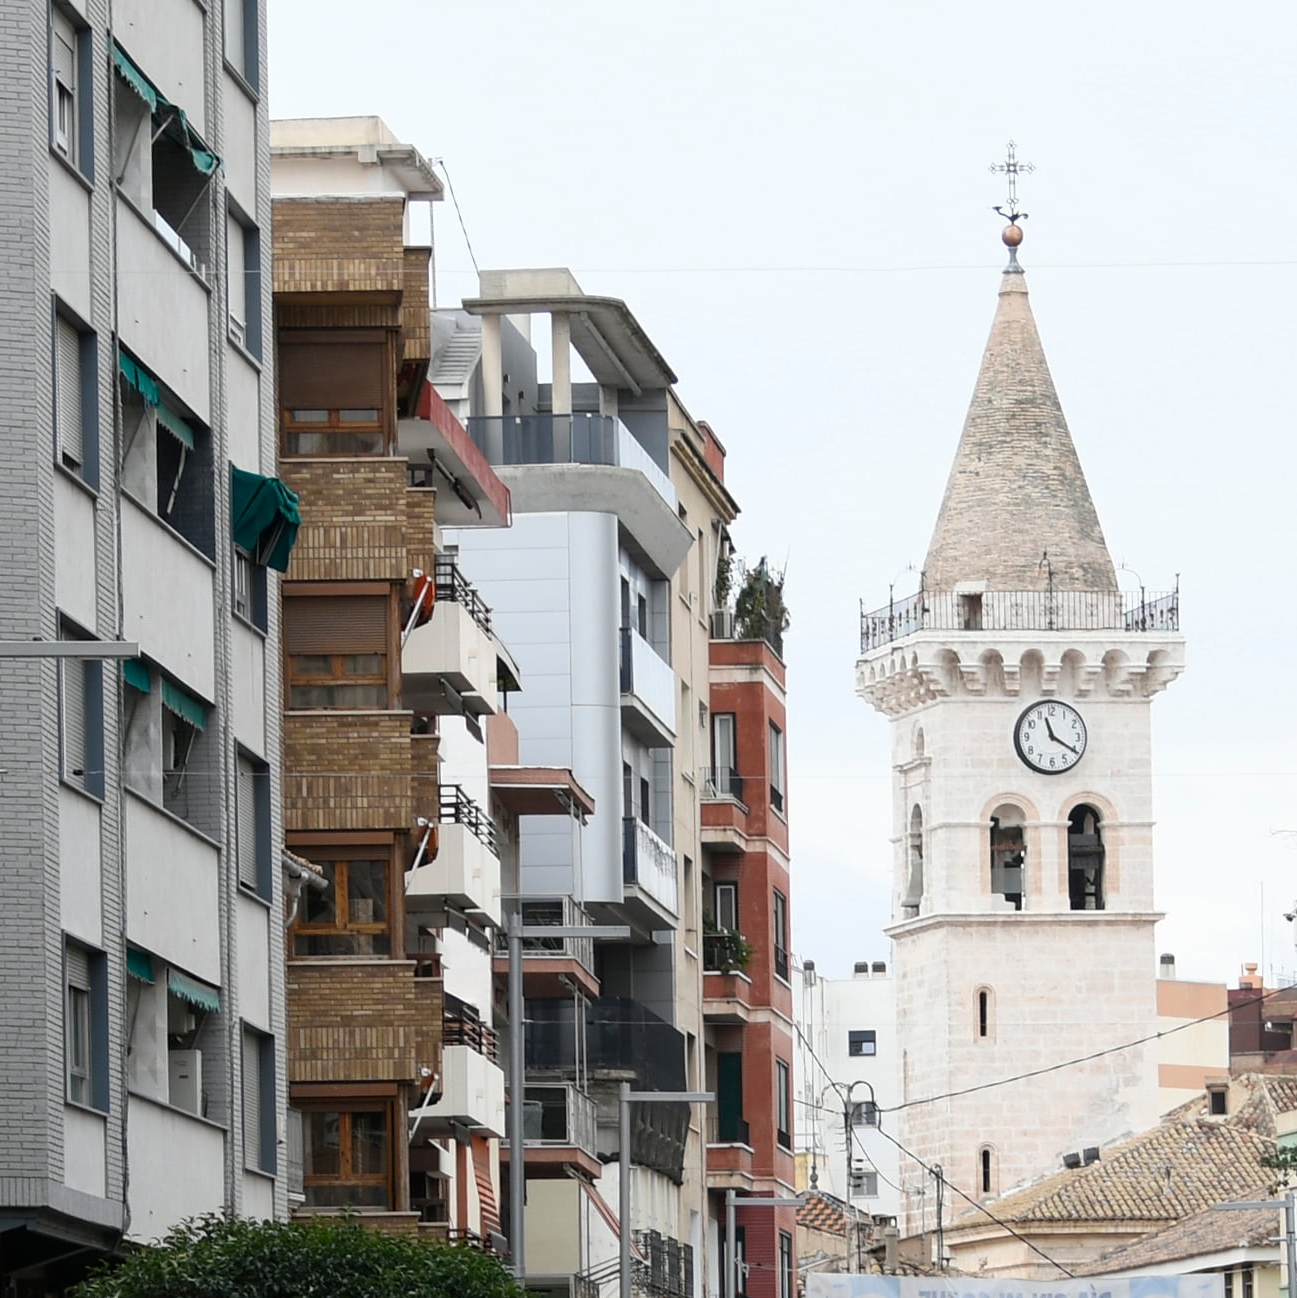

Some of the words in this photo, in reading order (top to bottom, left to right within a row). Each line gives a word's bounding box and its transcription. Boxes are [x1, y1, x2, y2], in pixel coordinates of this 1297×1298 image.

[1037, 710, 1043, 720] 11
[1048, 706, 1056, 716] 12
[1028, 720, 1036, 729] 10
[1072, 720, 1077, 729] 2
[1024, 732, 1030, 742] 9
[1075, 733, 1081, 742] 3
[1028, 746, 1034, 755] 8
[1037, 754, 1043, 763] 7
[1049, 757, 1055, 767] 6
[1062, 754, 1067, 763] 5
